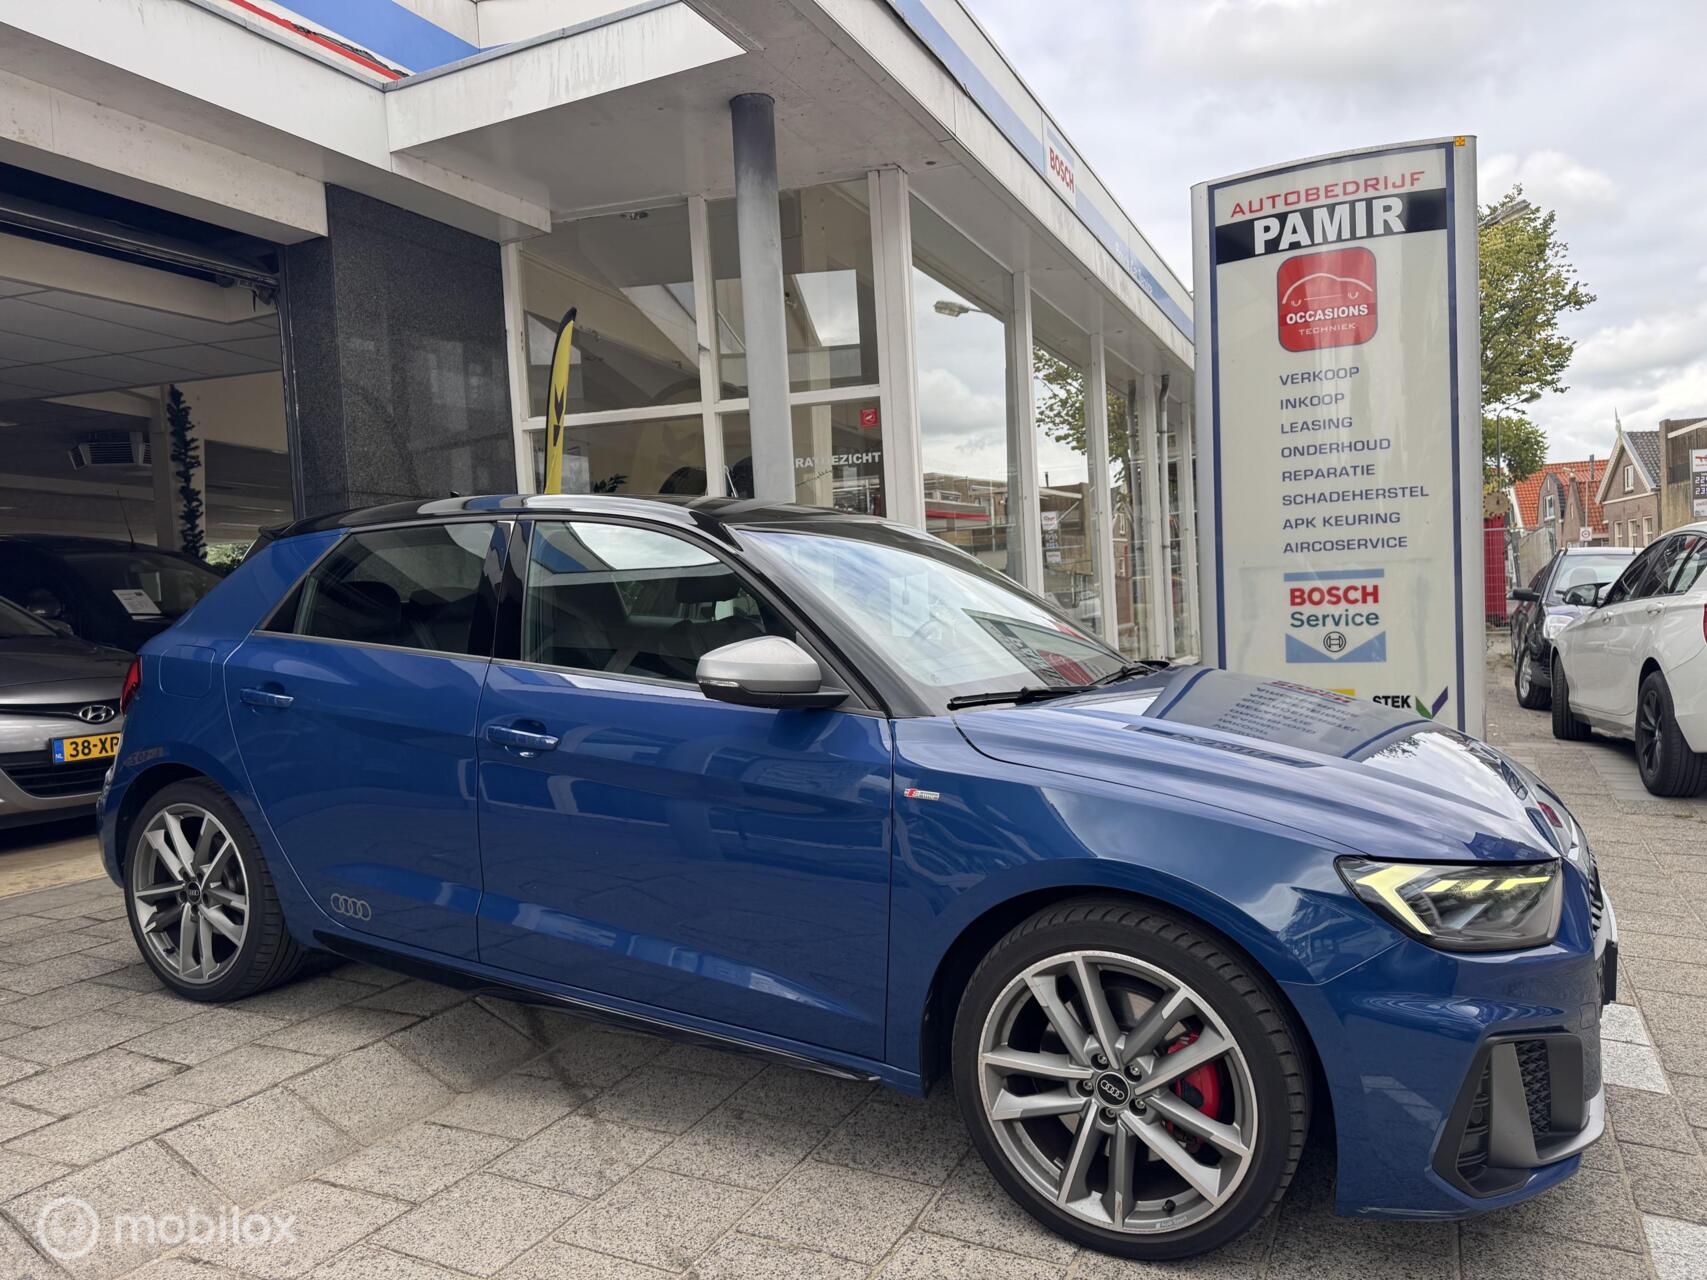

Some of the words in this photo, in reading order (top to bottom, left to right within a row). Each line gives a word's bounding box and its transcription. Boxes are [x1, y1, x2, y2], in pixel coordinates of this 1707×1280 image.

[1049, 146, 1074, 193] BOSCH
[1230, 171, 1425, 218] AUTOBEDRIJF
[1253, 196, 1406, 255] PAMIR
[1286, 304, 1368, 324] OCCASIONS
[1298, 323, 1356, 335] TECHNIEK
[1280, 366, 1360, 386] VERKOOP
[1280, 393, 1345, 410] INKOOP
[1281, 416, 1353, 434] LEASING
[1281, 438, 1391, 458] ONDERHOUD
[1282, 464, 1376, 482] REPARATIE
[1282, 486, 1429, 506] SCHADEHERSTEL
[1283, 517, 1317, 530] APK
[1322, 511, 1401, 528] KEURING
[1283, 536, 1408, 553] AIRCOSERVICE
[1290, 584, 1379, 606] BOSCH
[1290, 608, 1380, 628] Service
[1373, 695, 1412, 709] STEK
[69, 736, 120, 758] 38-XP
